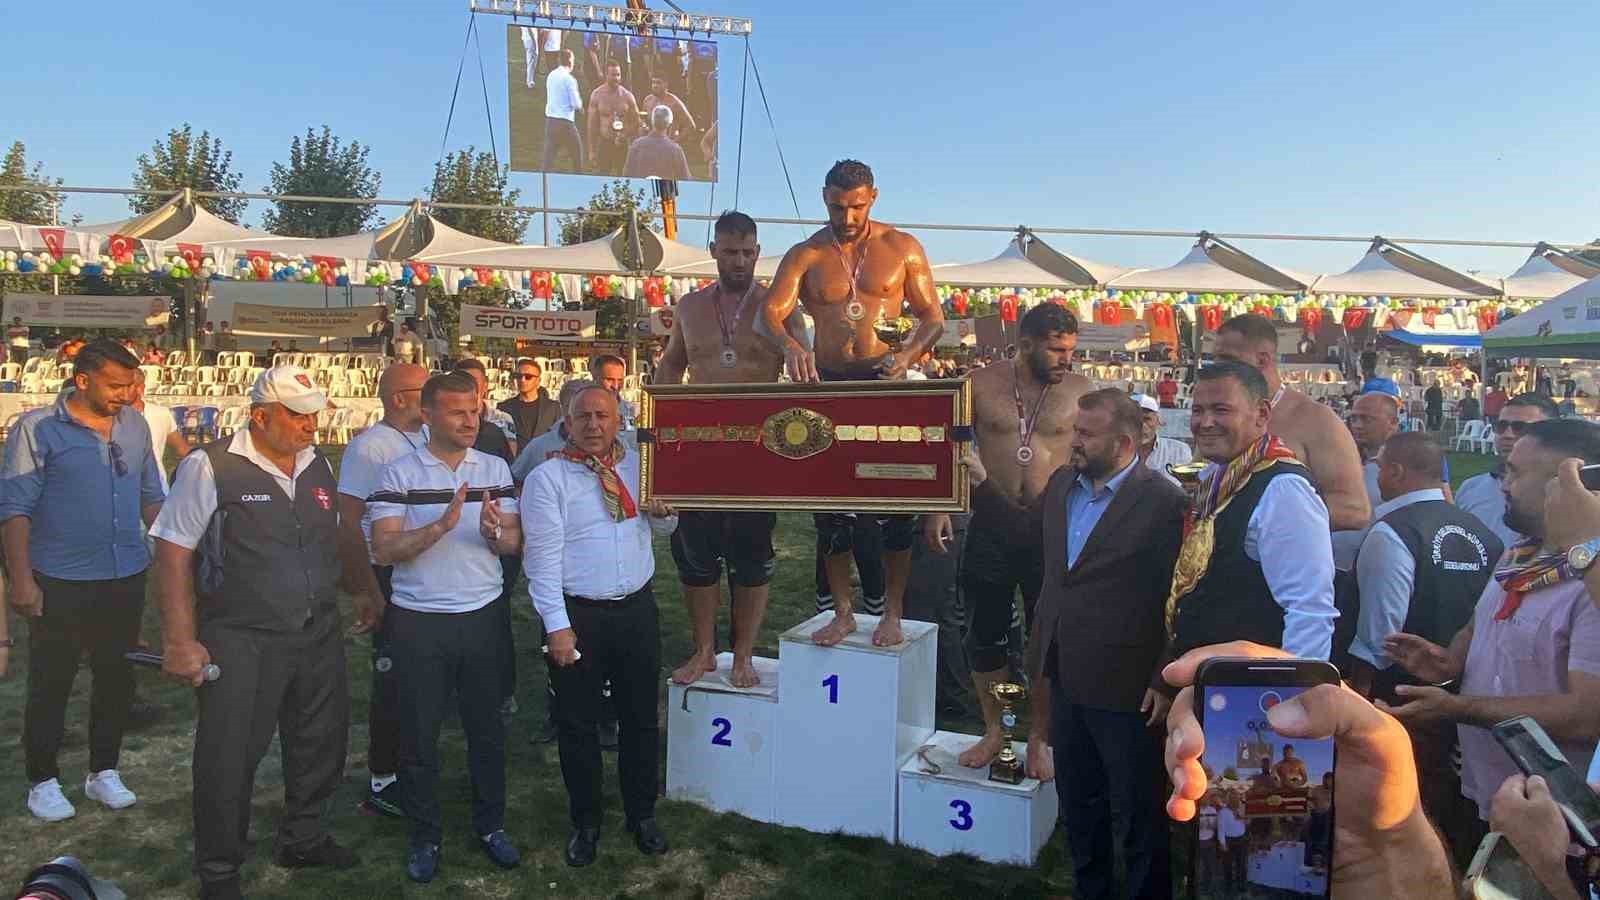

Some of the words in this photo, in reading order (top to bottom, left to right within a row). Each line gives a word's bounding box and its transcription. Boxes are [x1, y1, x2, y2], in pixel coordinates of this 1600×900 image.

[822, 674, 839, 704] 1
[711, 717, 732, 747] 2
[949, 799, 974, 831] 3
